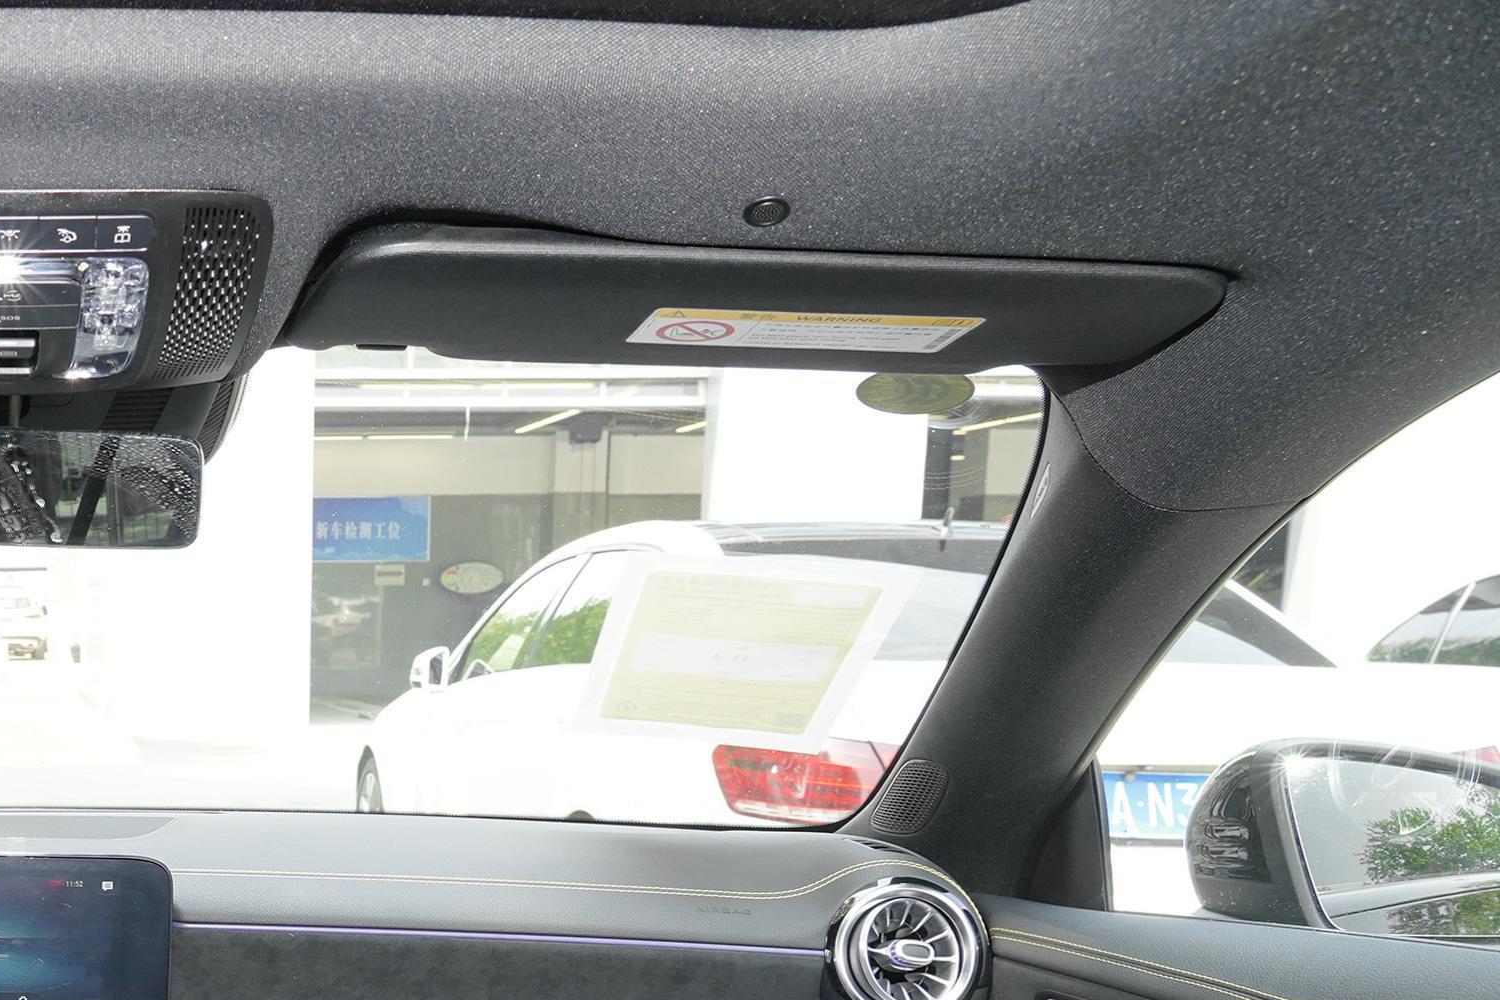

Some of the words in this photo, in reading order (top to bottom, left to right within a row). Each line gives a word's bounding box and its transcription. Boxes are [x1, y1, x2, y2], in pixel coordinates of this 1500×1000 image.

[797, 315, 882, 323] WARNING
[315, 521, 402, 540] 新车检测工位
[65, 880, 84, 888] 11:52
[695, 905, 752, 916] AIRBAG
